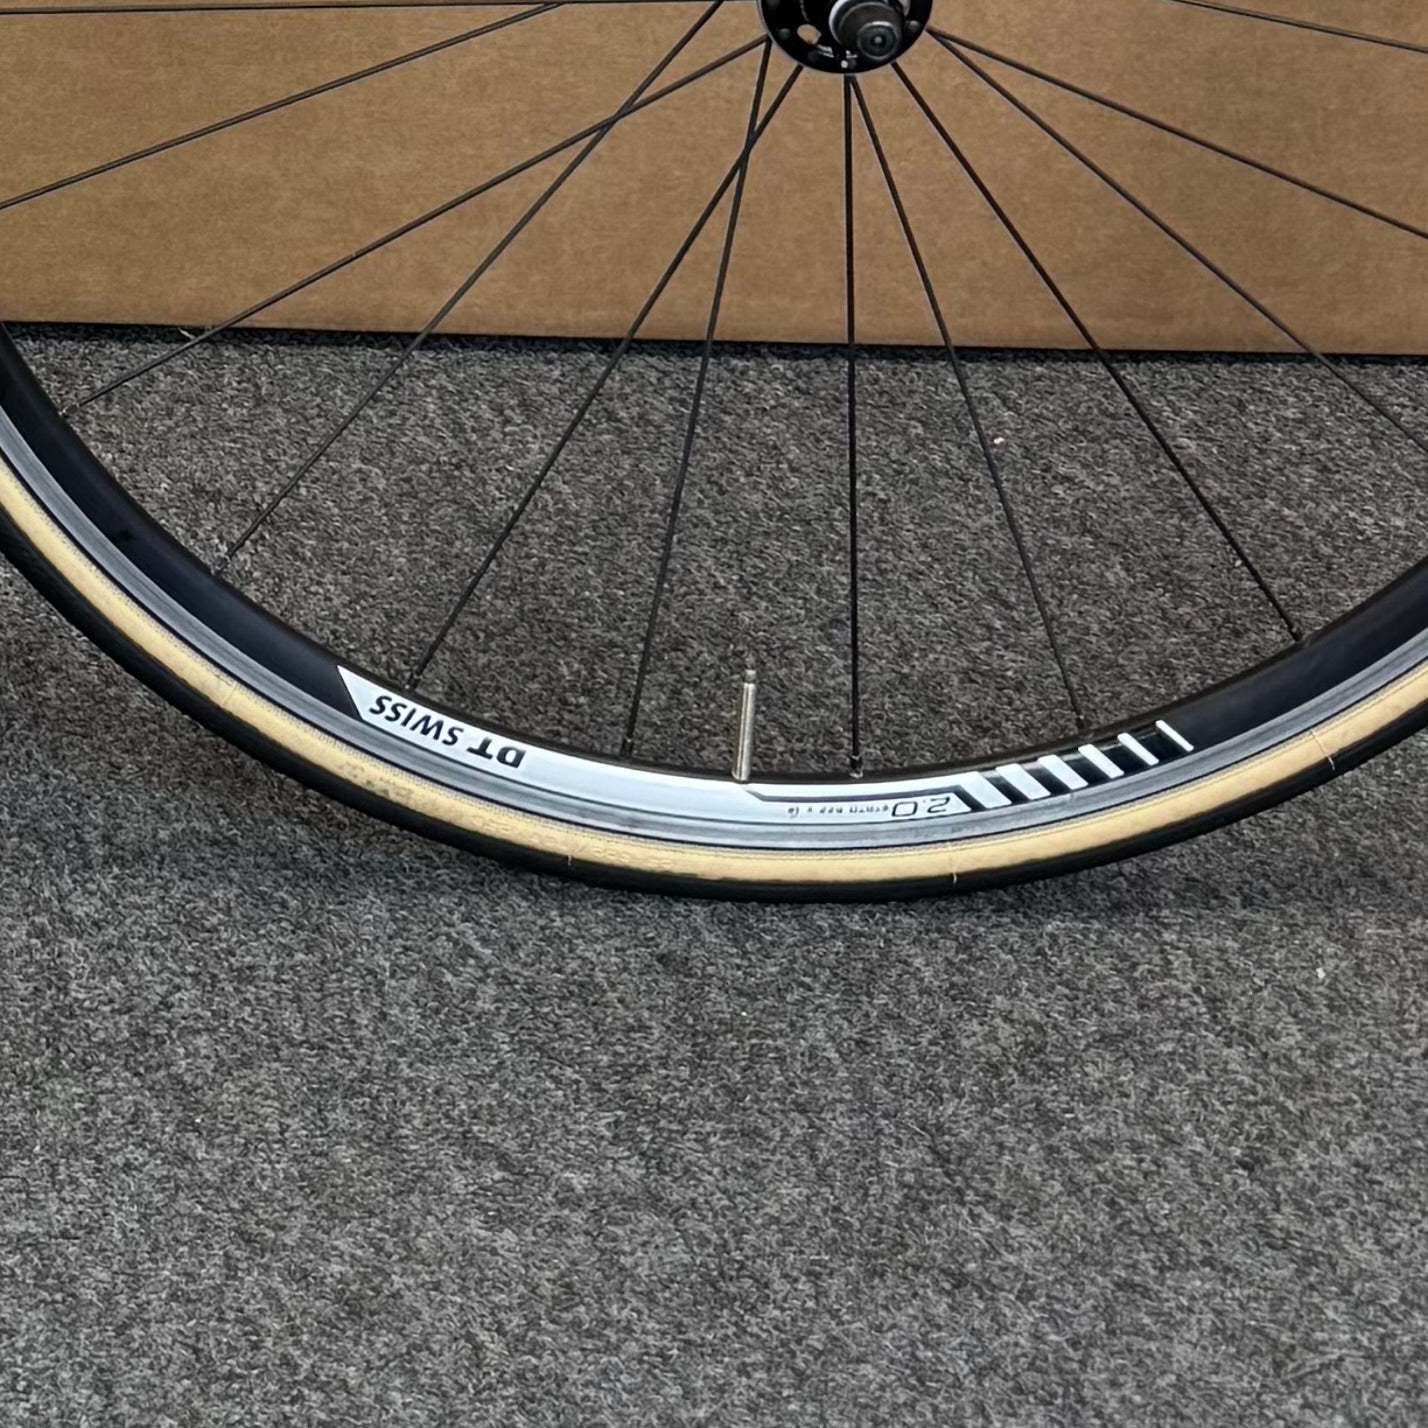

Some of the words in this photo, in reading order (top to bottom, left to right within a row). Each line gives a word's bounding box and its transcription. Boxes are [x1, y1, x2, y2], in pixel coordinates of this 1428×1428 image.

[367, 694, 466, 747] SWISS
[466, 736, 528, 770] DT
[890, 796, 952, 819] 2.0
